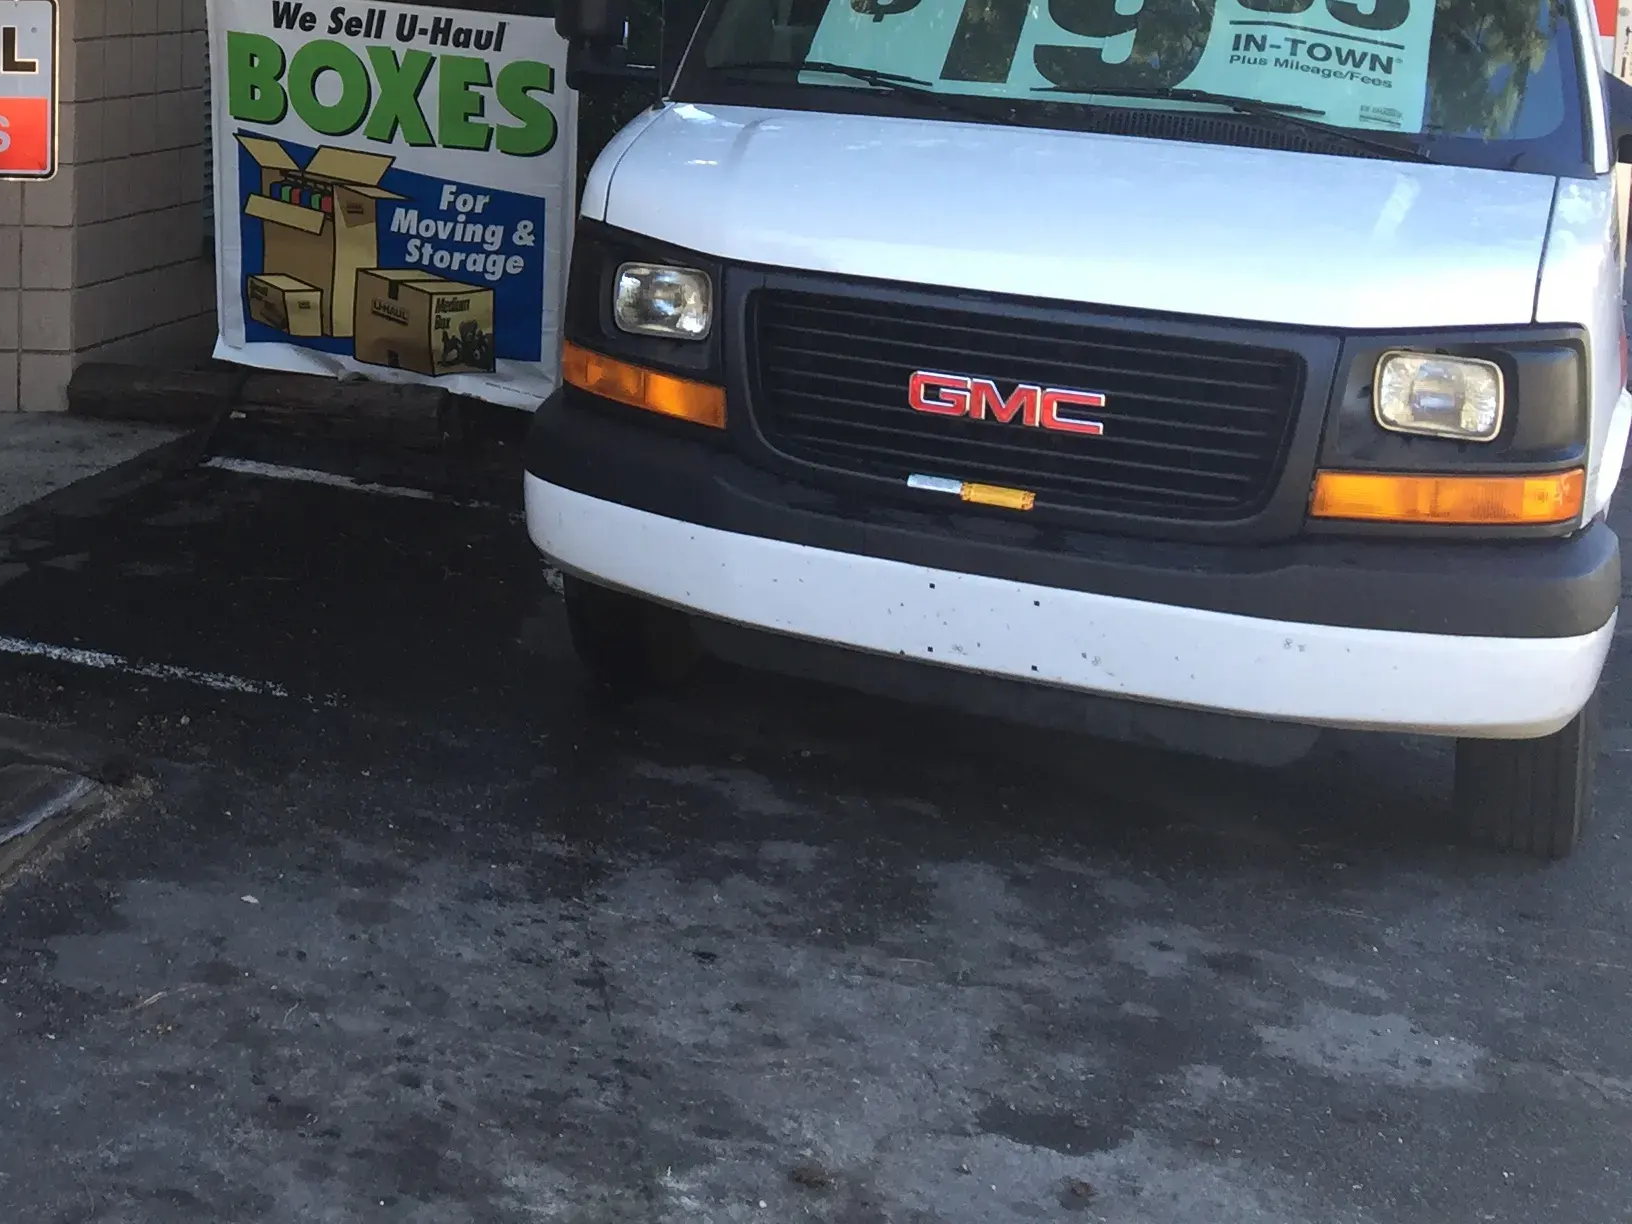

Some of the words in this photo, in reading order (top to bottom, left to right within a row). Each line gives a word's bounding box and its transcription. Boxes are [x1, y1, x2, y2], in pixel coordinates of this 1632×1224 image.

[272, 0, 317, 32] We
[327, 5, 386, 40] Sell
[396, 12, 509, 53] U-Haul
[226, 29, 559, 157] BOXES
[1229, 54, 1268, 67] Plus
[1273, 57, 1393, 89] Mileage/Fees
[439, 184, 490, 214] For
[390, 207, 504, 251] Moving
[512, 219, 536, 247] &
[405, 238, 526, 281] Storage
[908, 370, 1106, 435] GMC
